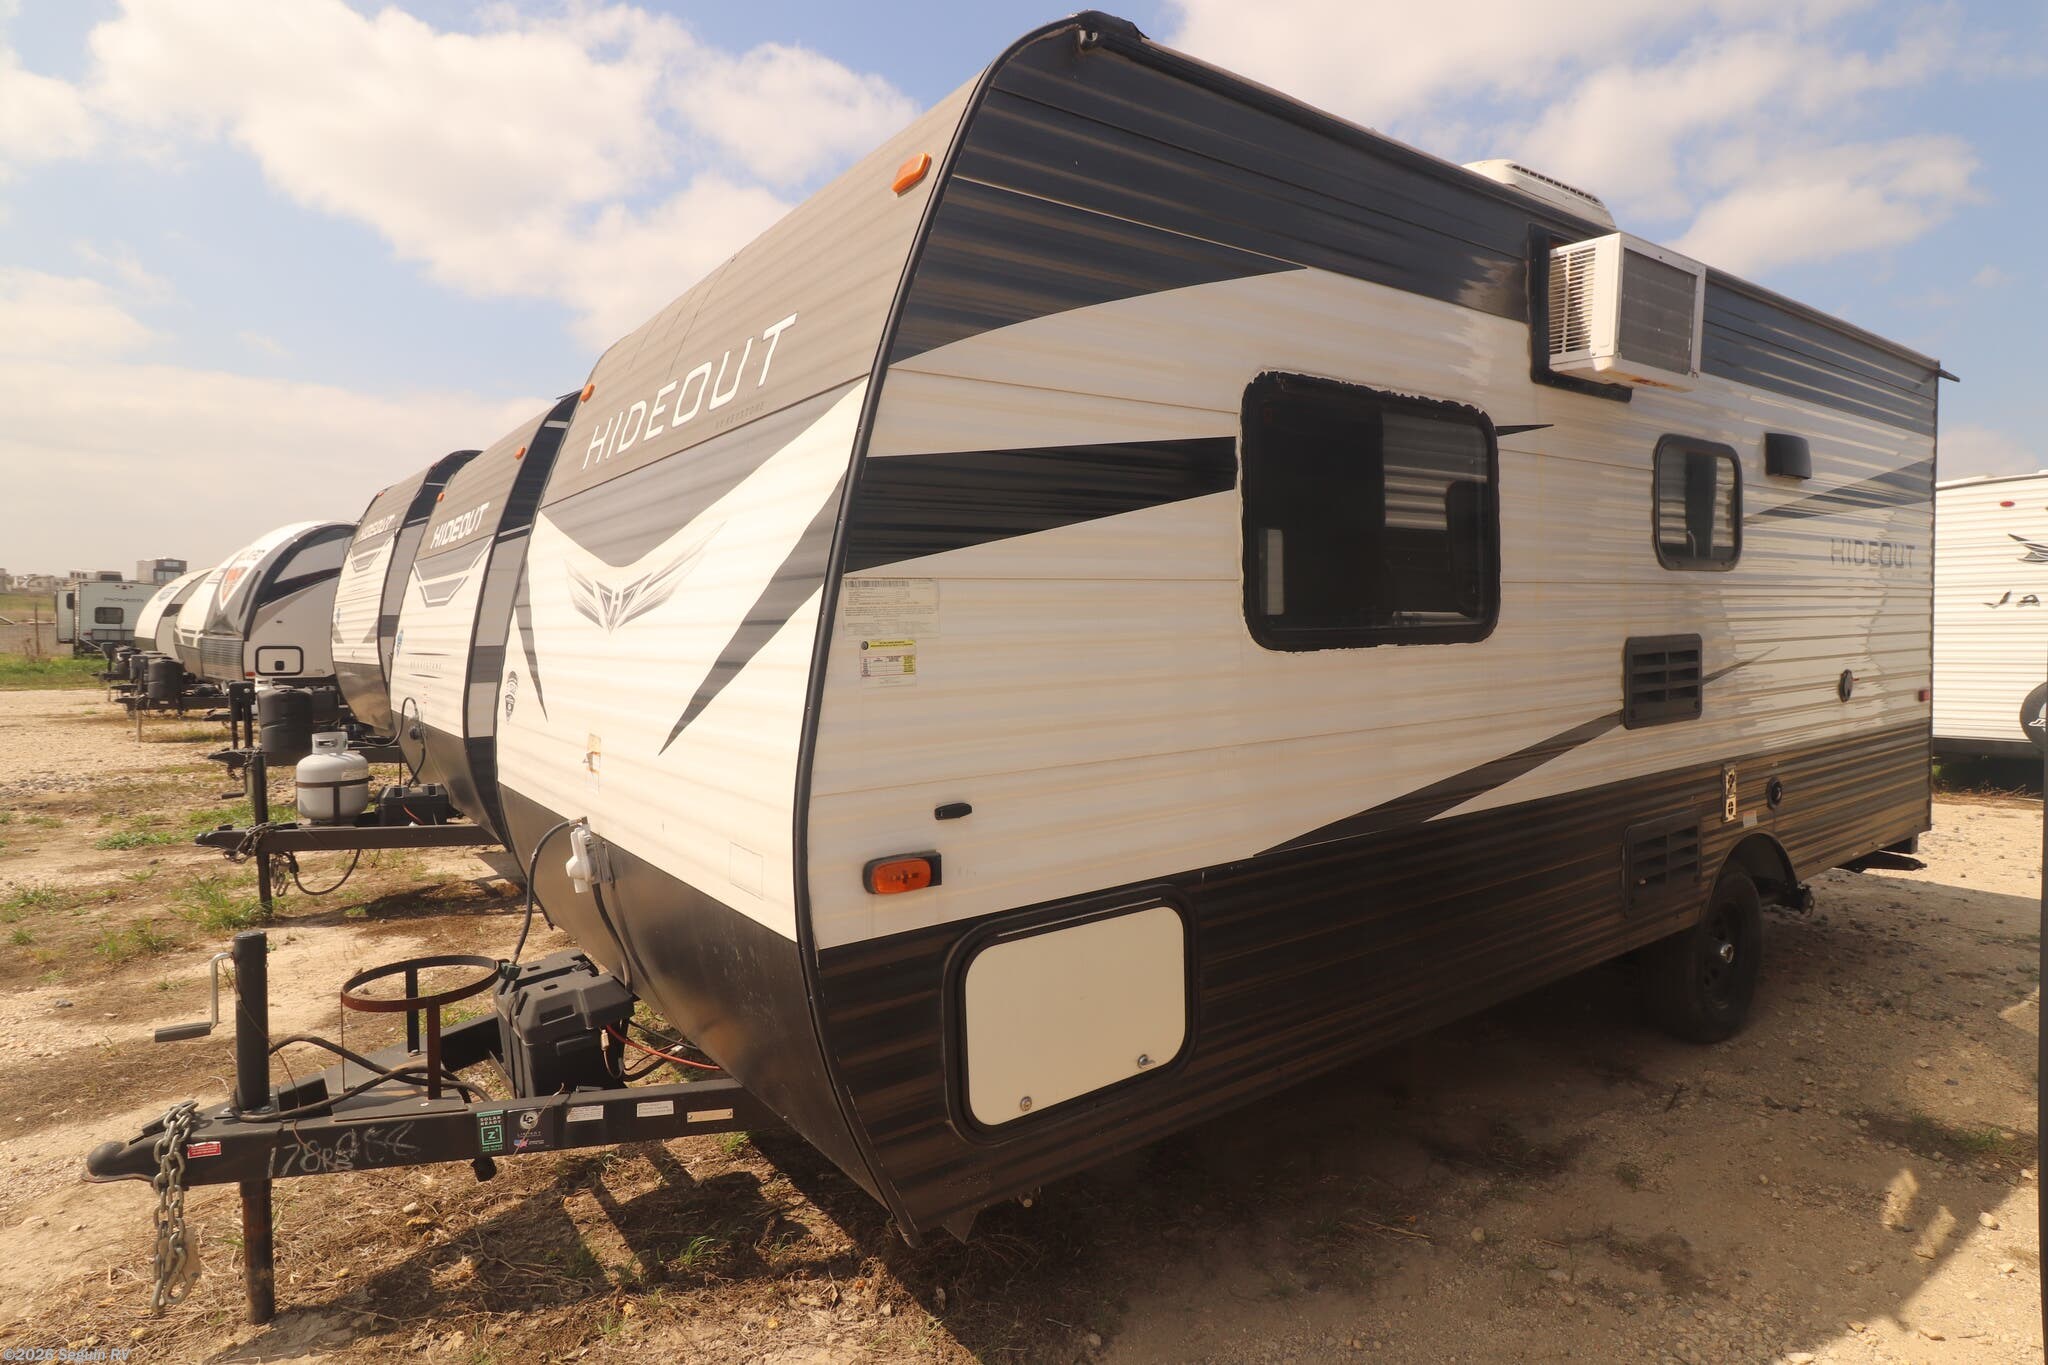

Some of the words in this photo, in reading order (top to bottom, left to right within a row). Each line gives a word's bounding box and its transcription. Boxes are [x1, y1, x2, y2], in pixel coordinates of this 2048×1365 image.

[582, 313, 798, 470] HIDEOUT
[430, 502, 490, 549] HIDEOUT
[1831, 538, 1915, 568] HIDEOUT
